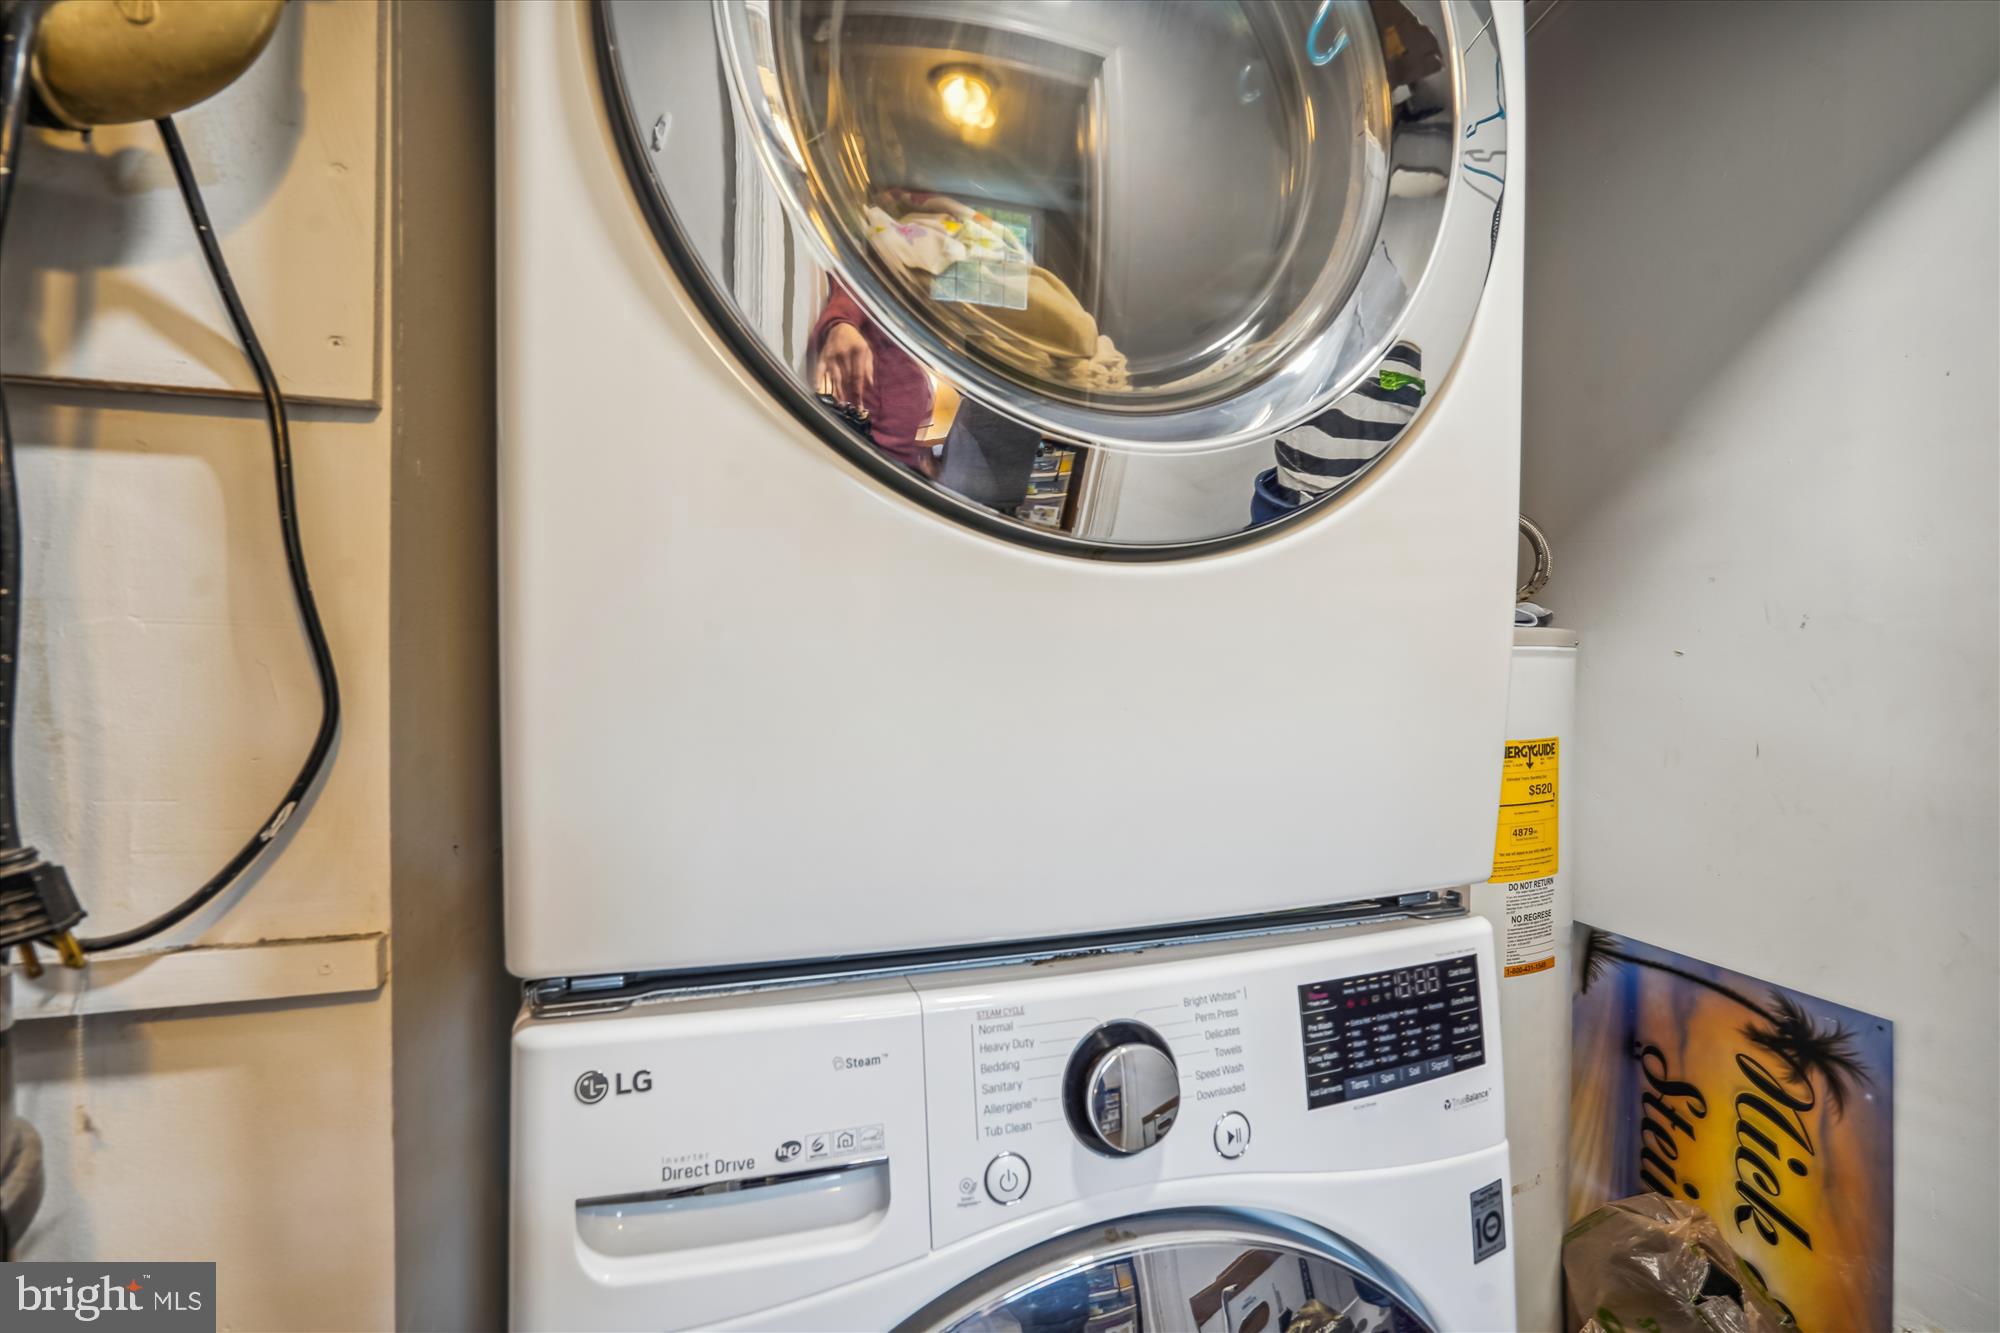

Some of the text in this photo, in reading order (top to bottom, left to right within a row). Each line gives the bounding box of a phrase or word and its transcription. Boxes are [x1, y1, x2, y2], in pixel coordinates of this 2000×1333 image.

[1504, 743, 1555, 759] ERGYGUIDE
[1512, 827, 1534, 837] 4879
[1508, 883, 1519, 892] DO
[1520, 881, 1532, 890] NOT
[1534, 877, 1554, 888] RETURN
[1511, 915, 1522, 924] NO
[1524, 909, 1552, 922] REGRESE
[1183, 996, 1208, 1008] Bright
[977, 1006, 1024, 1020] STEAM CYCLE
[1217, 1008, 1239, 1018] Press
[979, 1022, 1013, 1035] Normal
[1204, 1027, 1240, 1040] Delicates
[980, 1038, 1035, 1054] Heavy Duty
[1215, 1045, 1242, 1057] Towels
[980, 1061, 1020, 1075] Bedding
[1431, 1059, 1450, 1071] Signal
[1195, 1064, 1245, 1081] Speed Wash
[616, 1069, 652, 1095] LG
[982, 1081, 1023, 1095] Sanitary
[1196, 1083, 1246, 1101] Downloaded
[984, 1121, 1032, 1138] Tub Clean
[661, 1151, 709, 1165] Inverter
[1735, 1053, 1815, 1252] Nick
[662, 1158, 755, 1182] Direct Drive
[1475, 1210, 1502, 1248] 10
